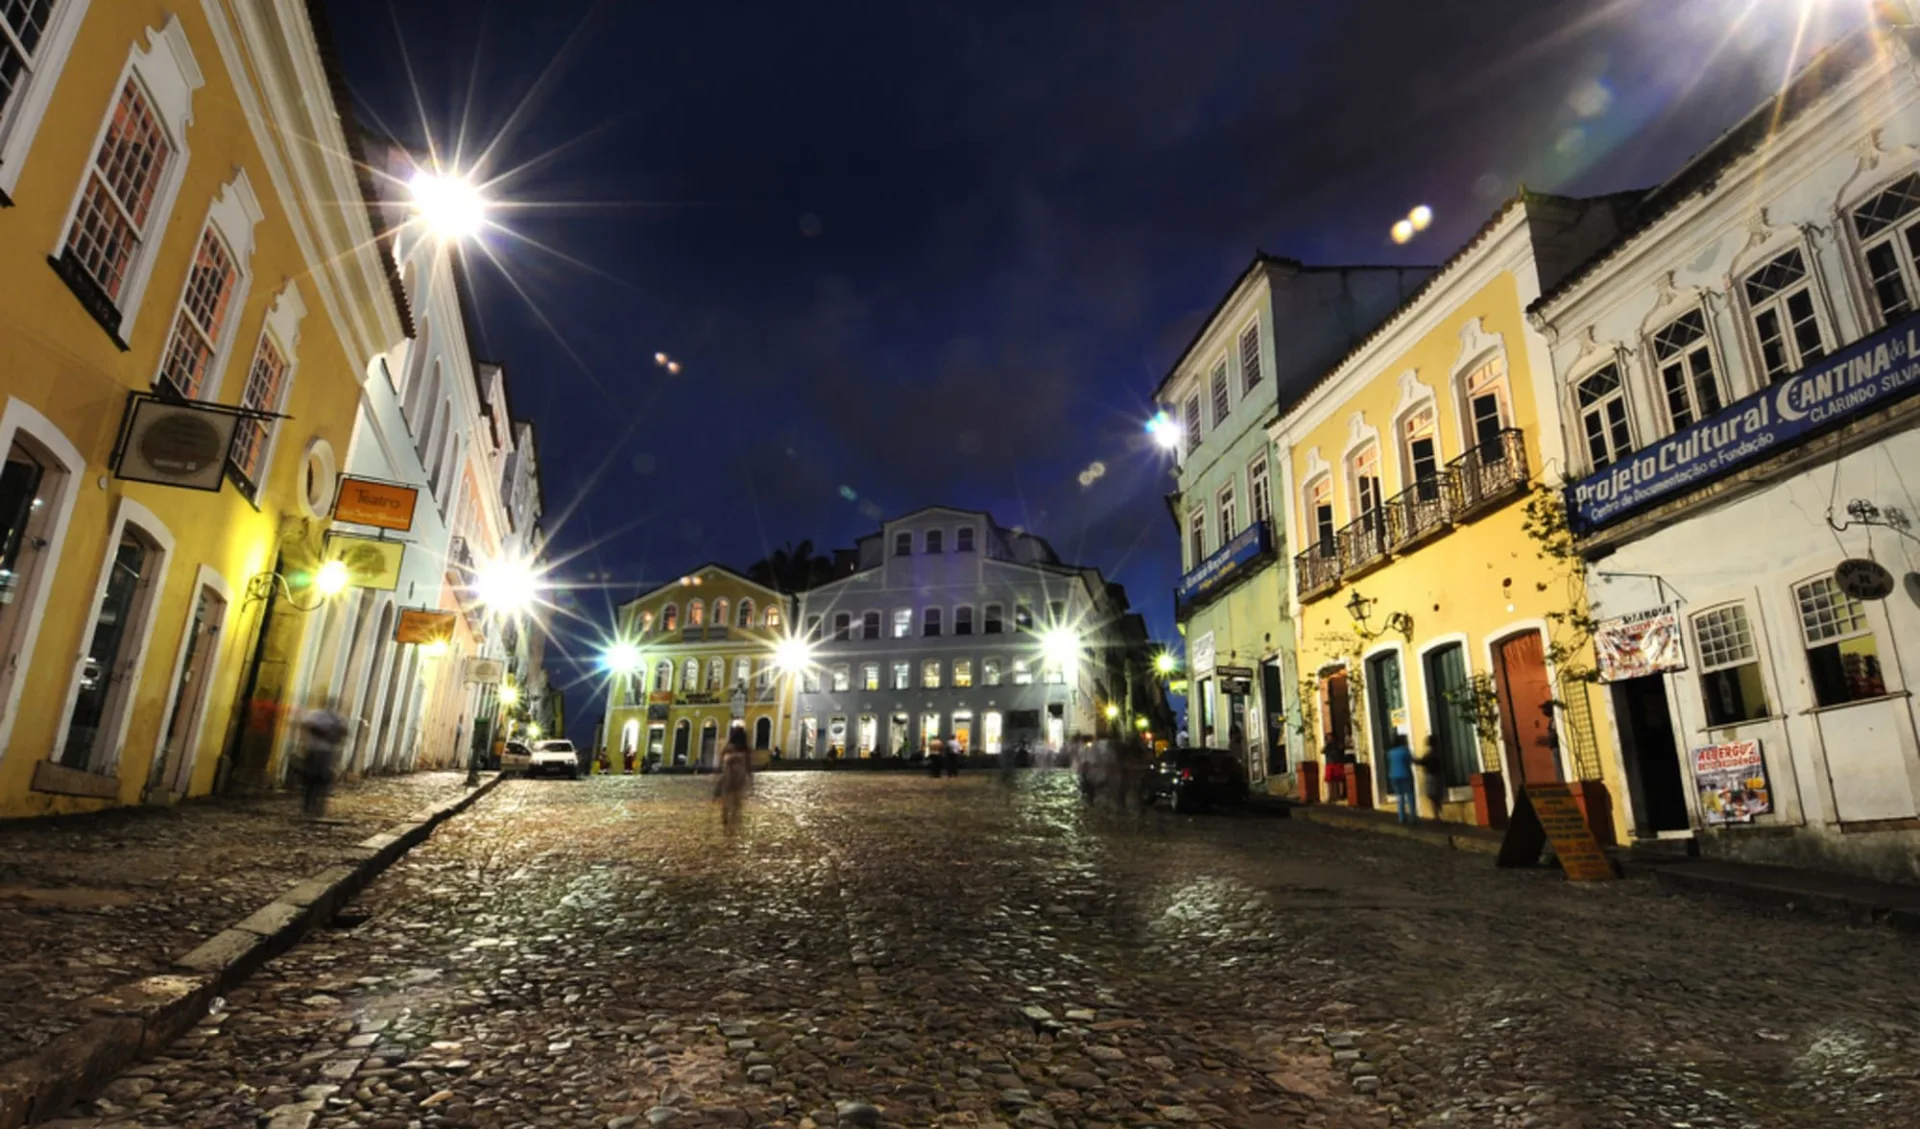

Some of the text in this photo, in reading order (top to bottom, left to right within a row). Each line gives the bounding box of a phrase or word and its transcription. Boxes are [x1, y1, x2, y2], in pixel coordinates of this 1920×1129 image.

[1575, 456, 1656, 511] Projeto
[1659, 396, 1769, 473] Cultural
[1776, 343, 1891, 421] CANTINA
[1591, 500, 1619, 521] Centro
[1621, 494, 1633, 506] de
[1709, 458, 1718, 469] e
[1719, 432, 1775, 465] Fundação
[1810, 384, 1877, 422] CLARINDO
[355, 487, 402, 509] Teatro
